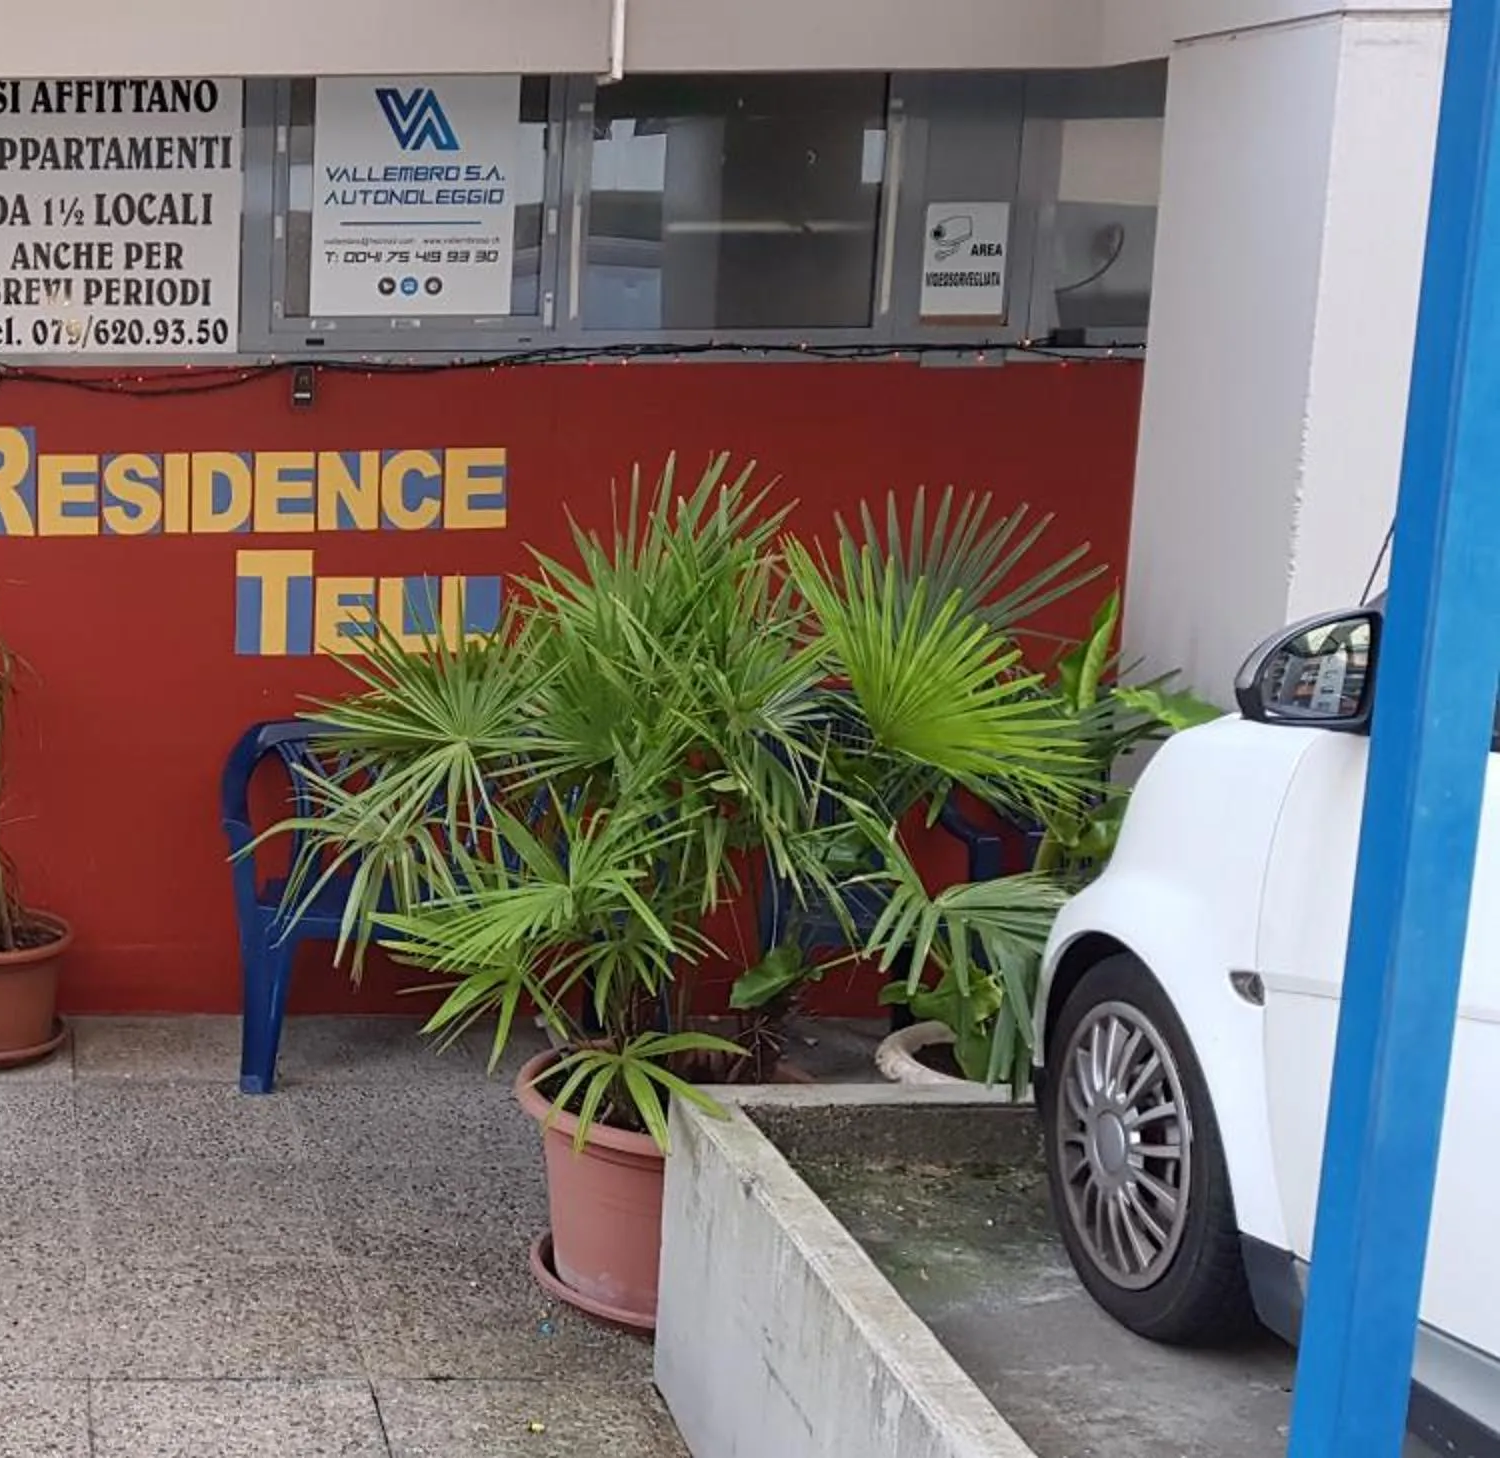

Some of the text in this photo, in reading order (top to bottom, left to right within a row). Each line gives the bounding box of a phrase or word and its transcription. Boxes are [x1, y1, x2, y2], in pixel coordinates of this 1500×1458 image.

[31, 79, 218, 113] AFFITTANO
[325, 166, 506, 182] VALLEMBRO S.A.
[94, 193, 212, 226] LOCALI
[324, 188, 504, 206] AUTONOLEGGIO
[10, 242, 184, 270] ANCHE PER
[325, 250, 499, 264] T: 0041 75 419 93 30
[970, 243, 1003, 256] AREA
[83, 278, 211, 306] PERIODI
[32, 315, 229, 348] 079/620.93.50
[235, 549, 500, 655] TELL
